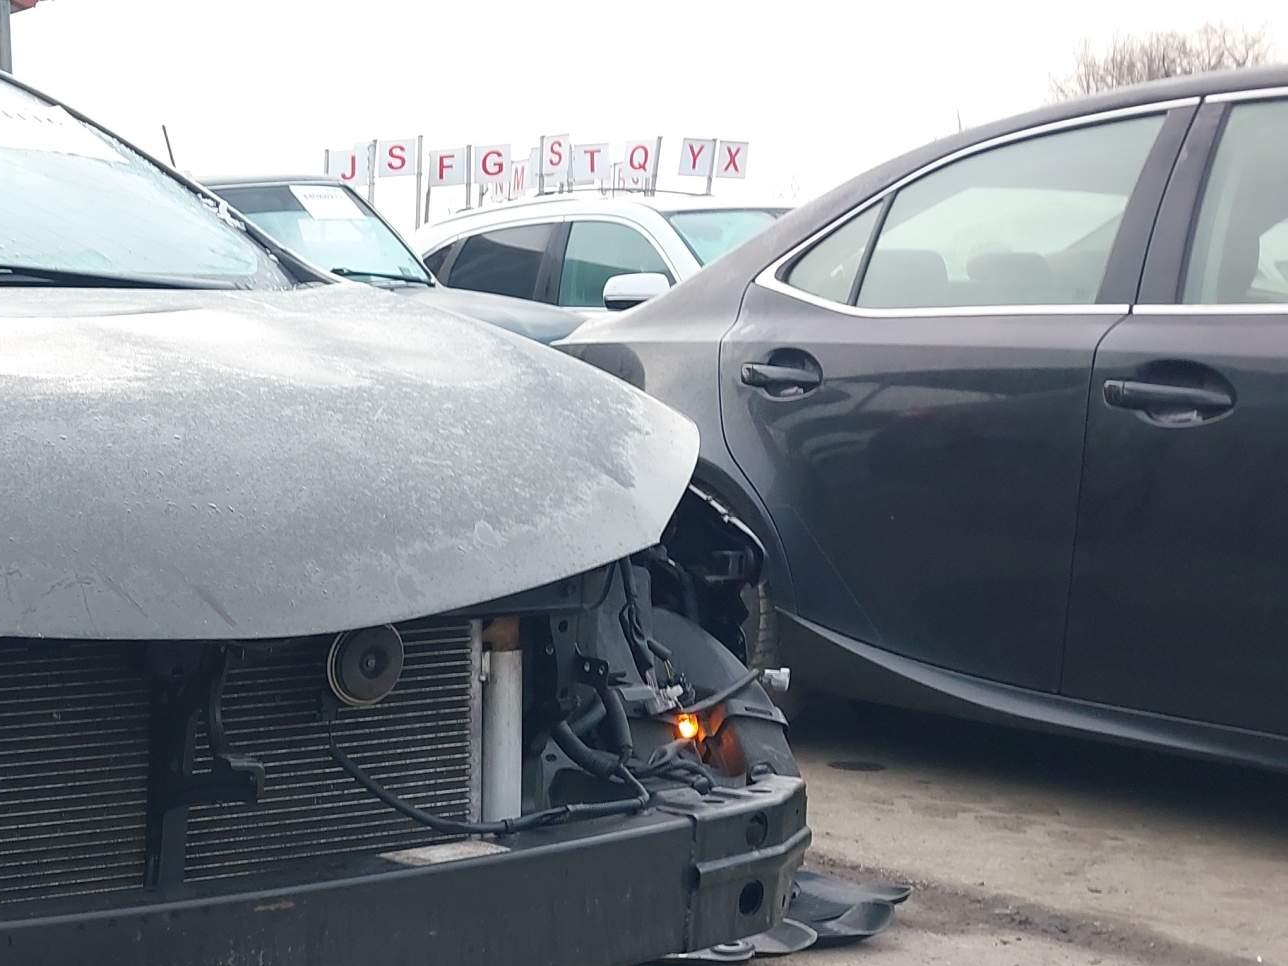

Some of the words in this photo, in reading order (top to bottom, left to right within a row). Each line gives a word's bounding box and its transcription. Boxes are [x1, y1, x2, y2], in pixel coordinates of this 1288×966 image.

[387, 145, 407, 171] S
[481, 150, 504, 176] G
[549, 140, 563, 167] S
[583, 149, 601, 174] T
[629, 144, 649, 172] Q
[688, 143, 705, 170] Y
[724, 145, 742, 172] X
[341, 154, 357, 180] J
[438, 154, 455, 180] F
[513, 165, 525, 191] M
